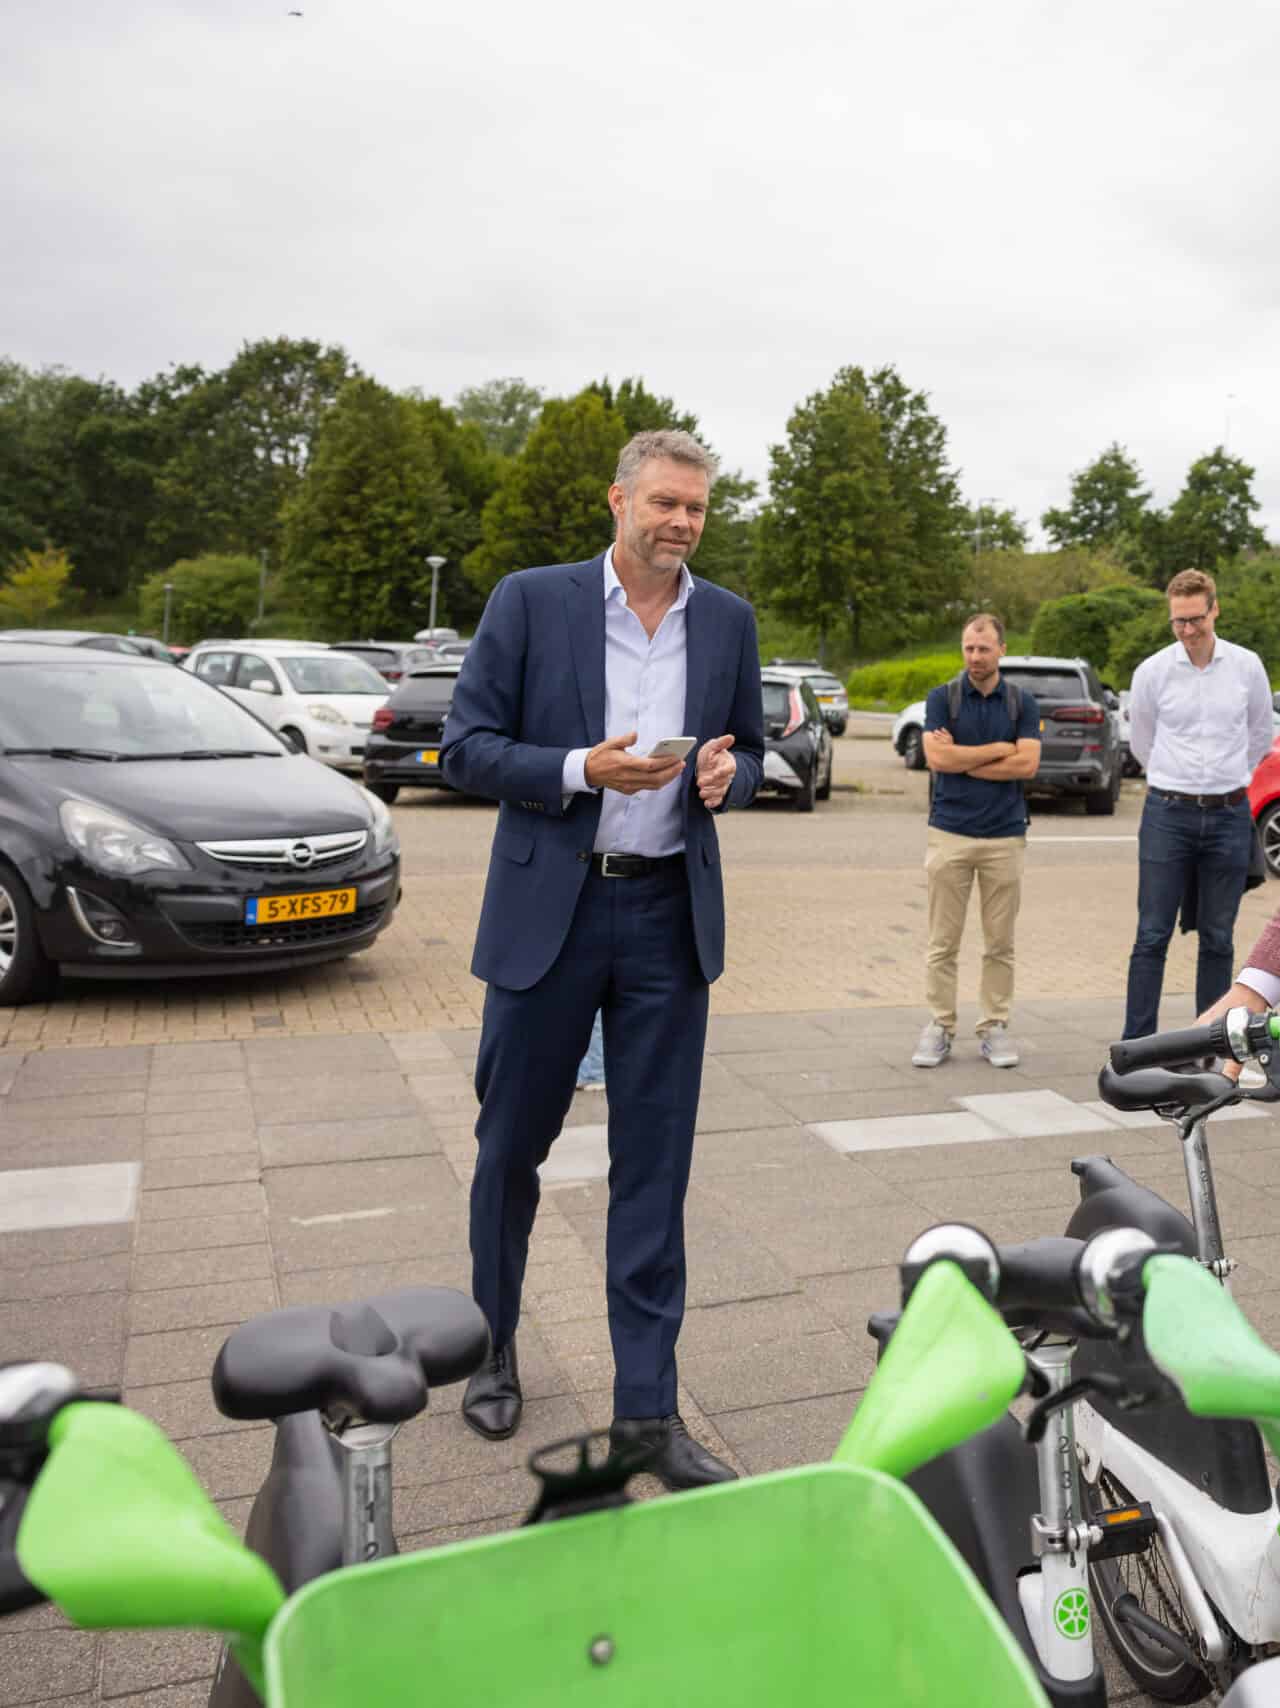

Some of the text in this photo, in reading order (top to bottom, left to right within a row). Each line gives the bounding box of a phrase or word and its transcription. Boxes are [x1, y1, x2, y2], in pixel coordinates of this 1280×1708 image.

[267, 891, 349, 918] 5-XFS-79
[1058, 1435, 1070, 1454] 2
[1062, 1470, 1072, 1489] 3
[365, 1501, 375, 1523] 1
